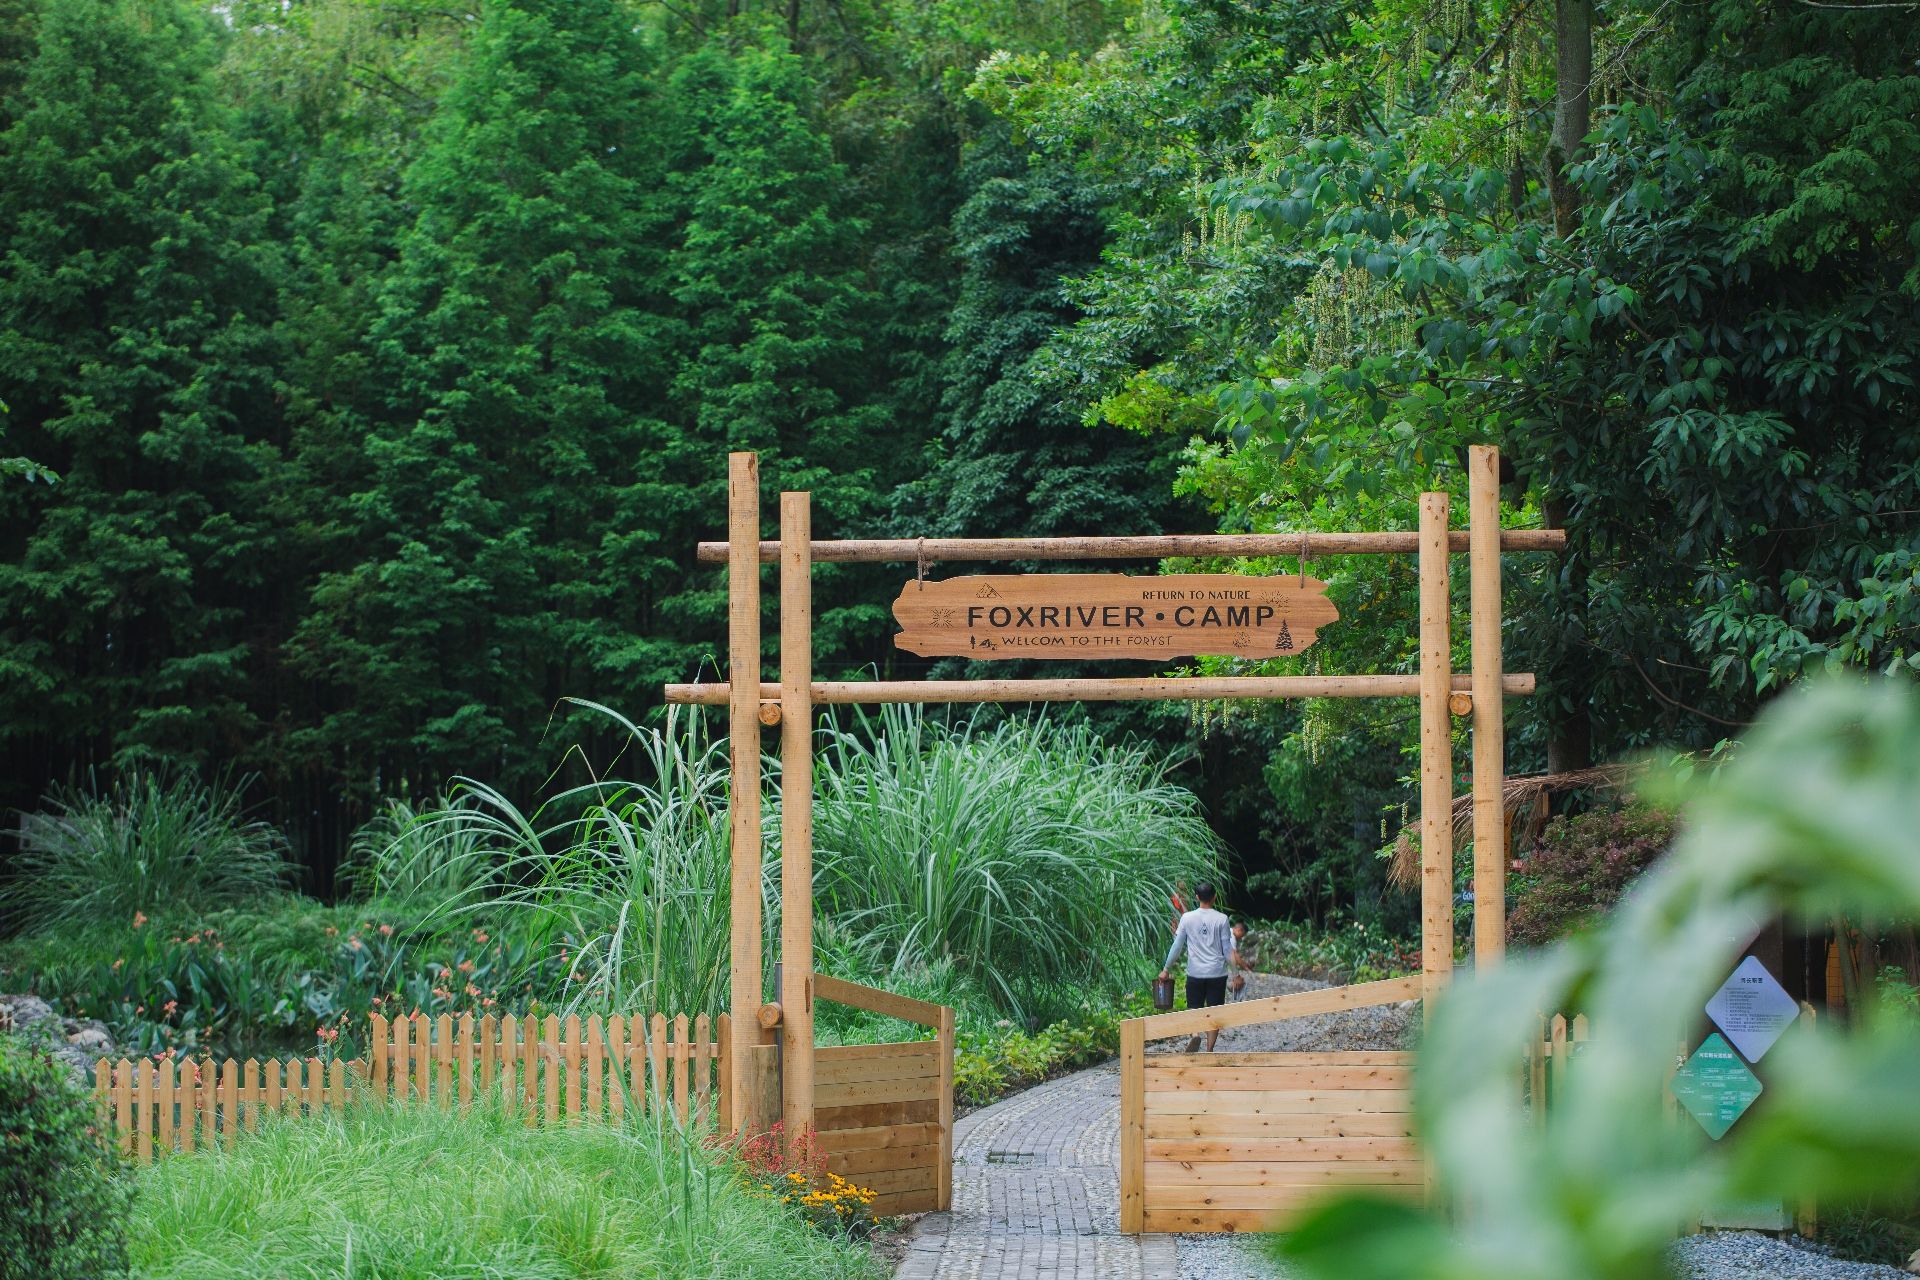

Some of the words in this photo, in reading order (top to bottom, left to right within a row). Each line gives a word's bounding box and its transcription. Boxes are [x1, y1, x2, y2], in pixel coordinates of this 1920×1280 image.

[1142, 590, 1185, 600] RETURN
[1189, 590, 1205, 600] TO
[1208, 590, 1251, 600] NATURE
[967, 606, 1145, 628] FOXRIVER
[1174, 605, 1274, 627] CAMP
[1001, 636, 1066, 646] WELCOM
[1070, 636, 1090, 646] TO
[1093, 636, 1121, 646] THE
[1127, 635, 1173, 646] FORYST
